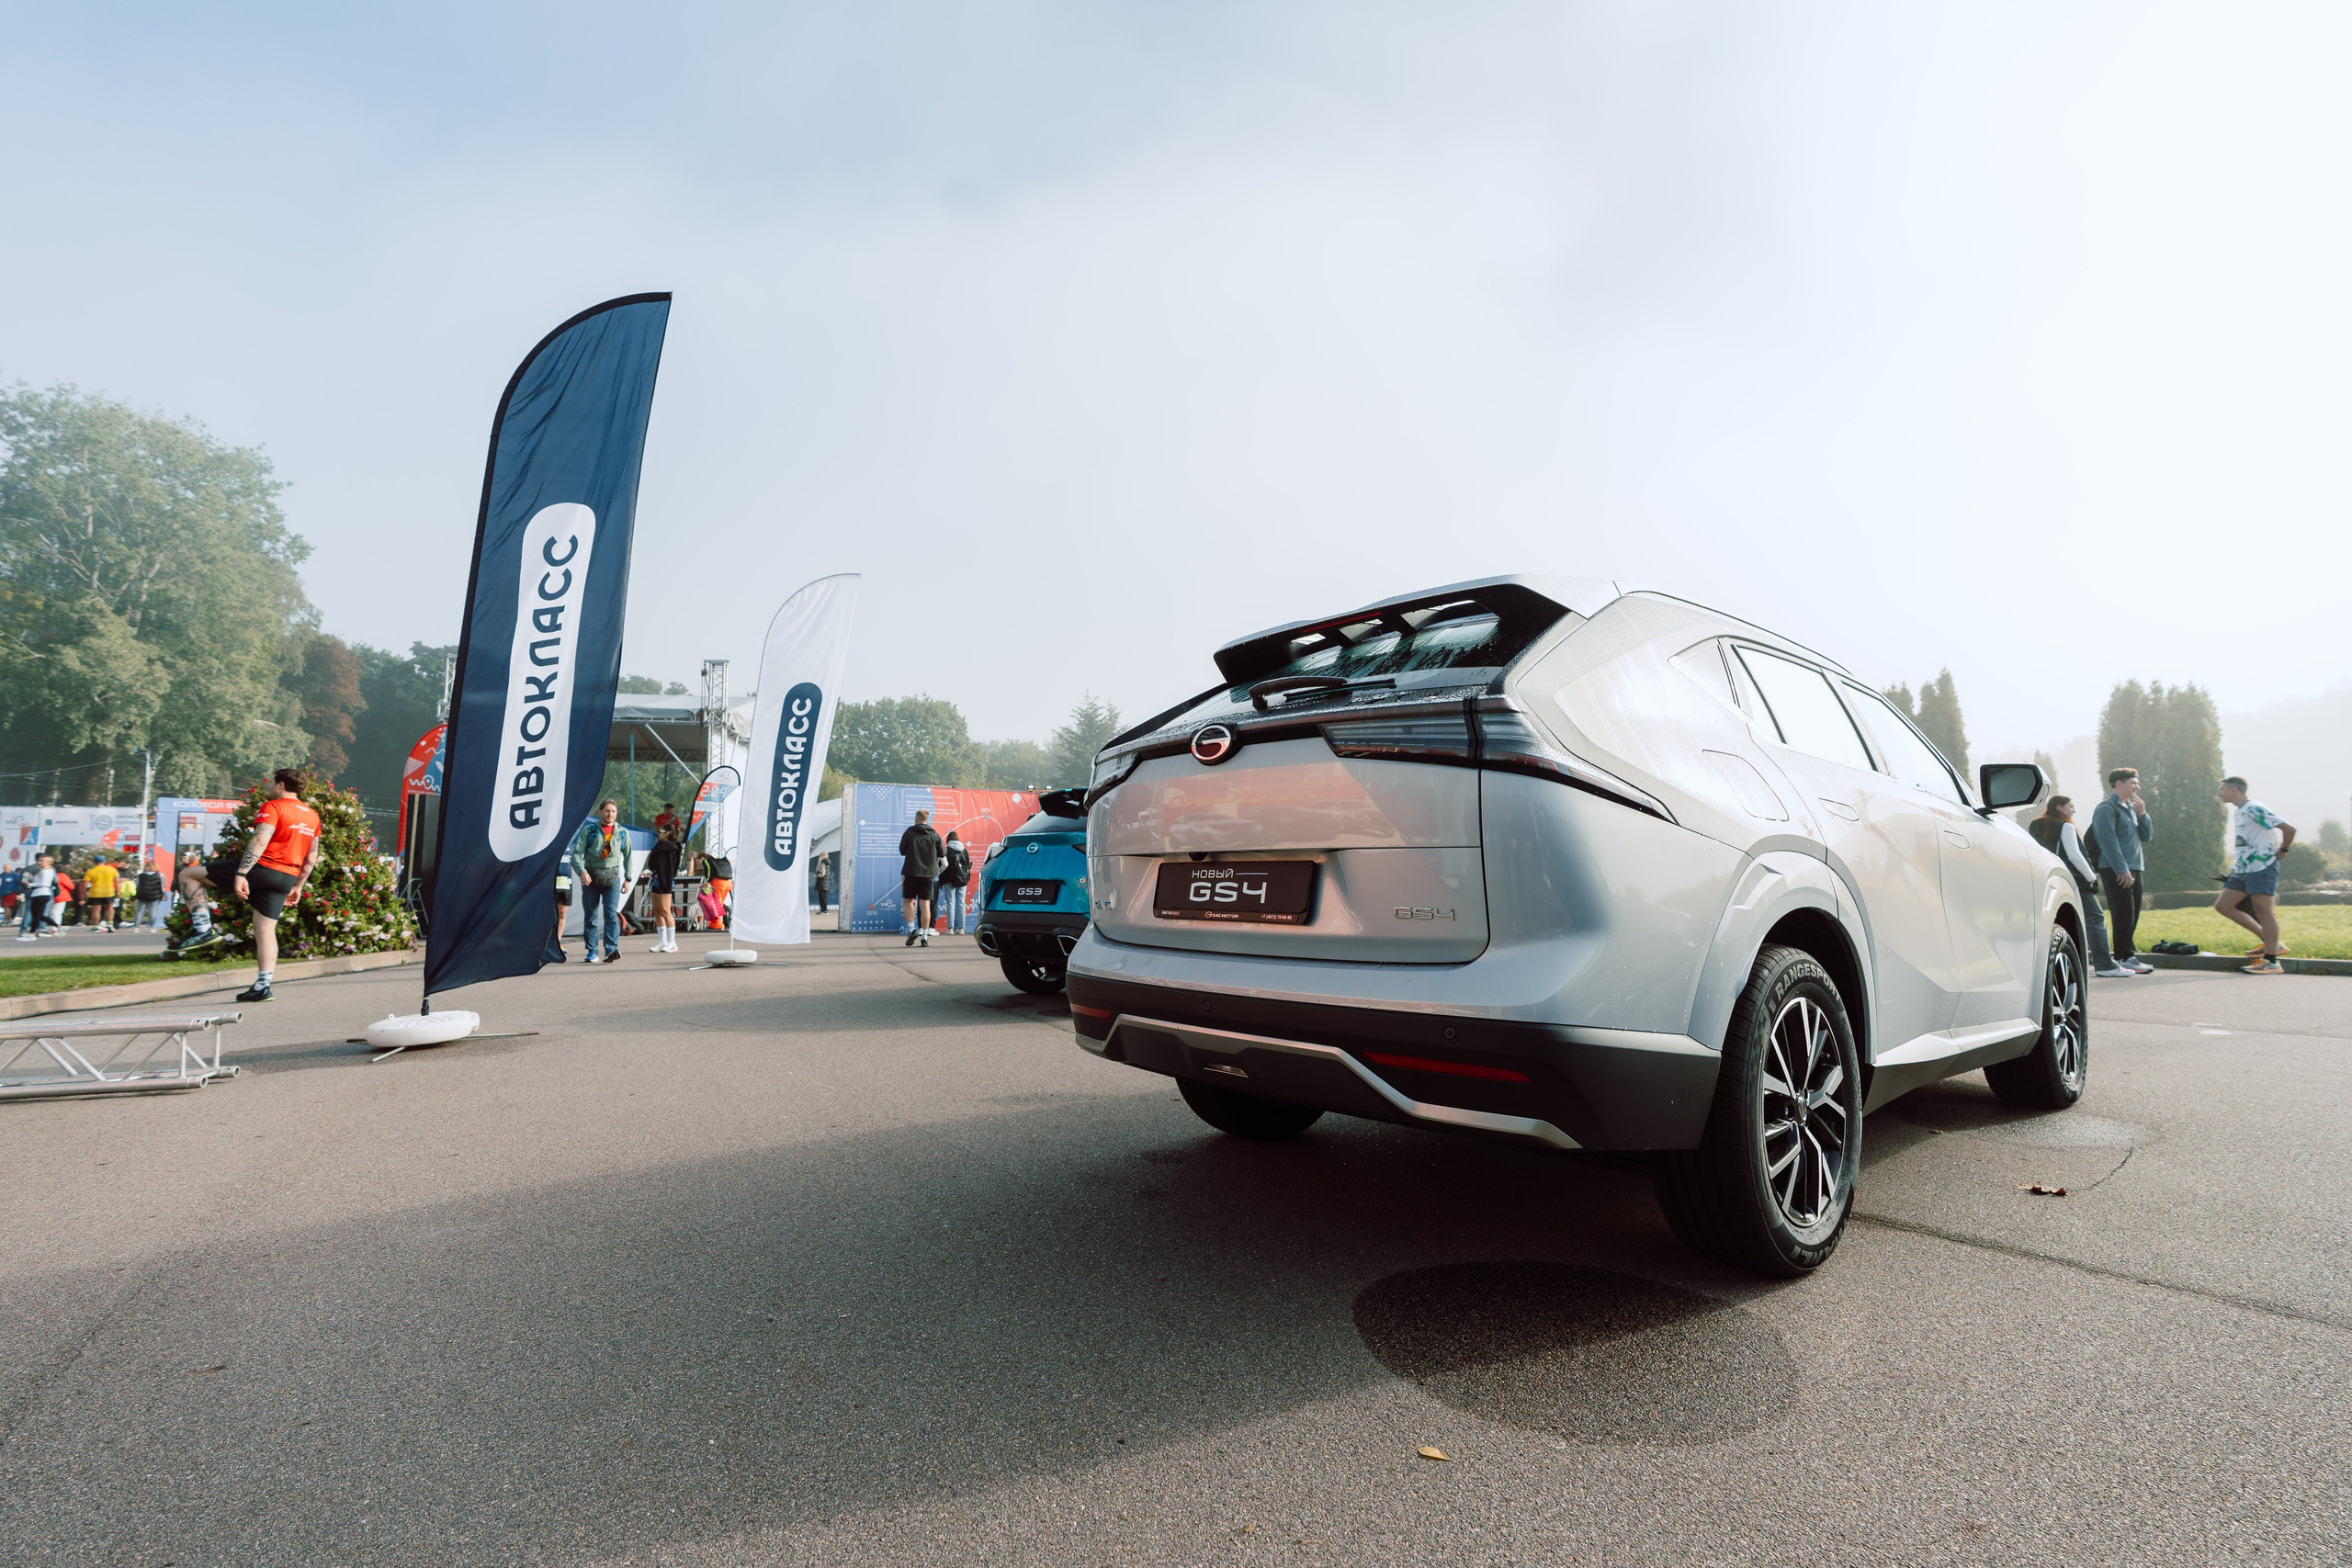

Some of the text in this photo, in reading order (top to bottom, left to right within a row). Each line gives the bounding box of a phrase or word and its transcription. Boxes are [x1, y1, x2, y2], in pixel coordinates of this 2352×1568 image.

[510, 534, 579, 829] АВТОКЛАСС
[775, 697, 812, 855] АВТОКЛАСС
[700, 784, 728, 798] 2:04
[173, 800, 223, 808] КОЛОКОЛ
[1192, 868, 1234, 879] НОВЫЙ
[1017, 887, 1043, 896] GS3
[1189, 881, 1268, 904] GS4
[1393, 905, 1456, 921] GS4
[1774, 963, 1842, 1002] RANGESPORT
